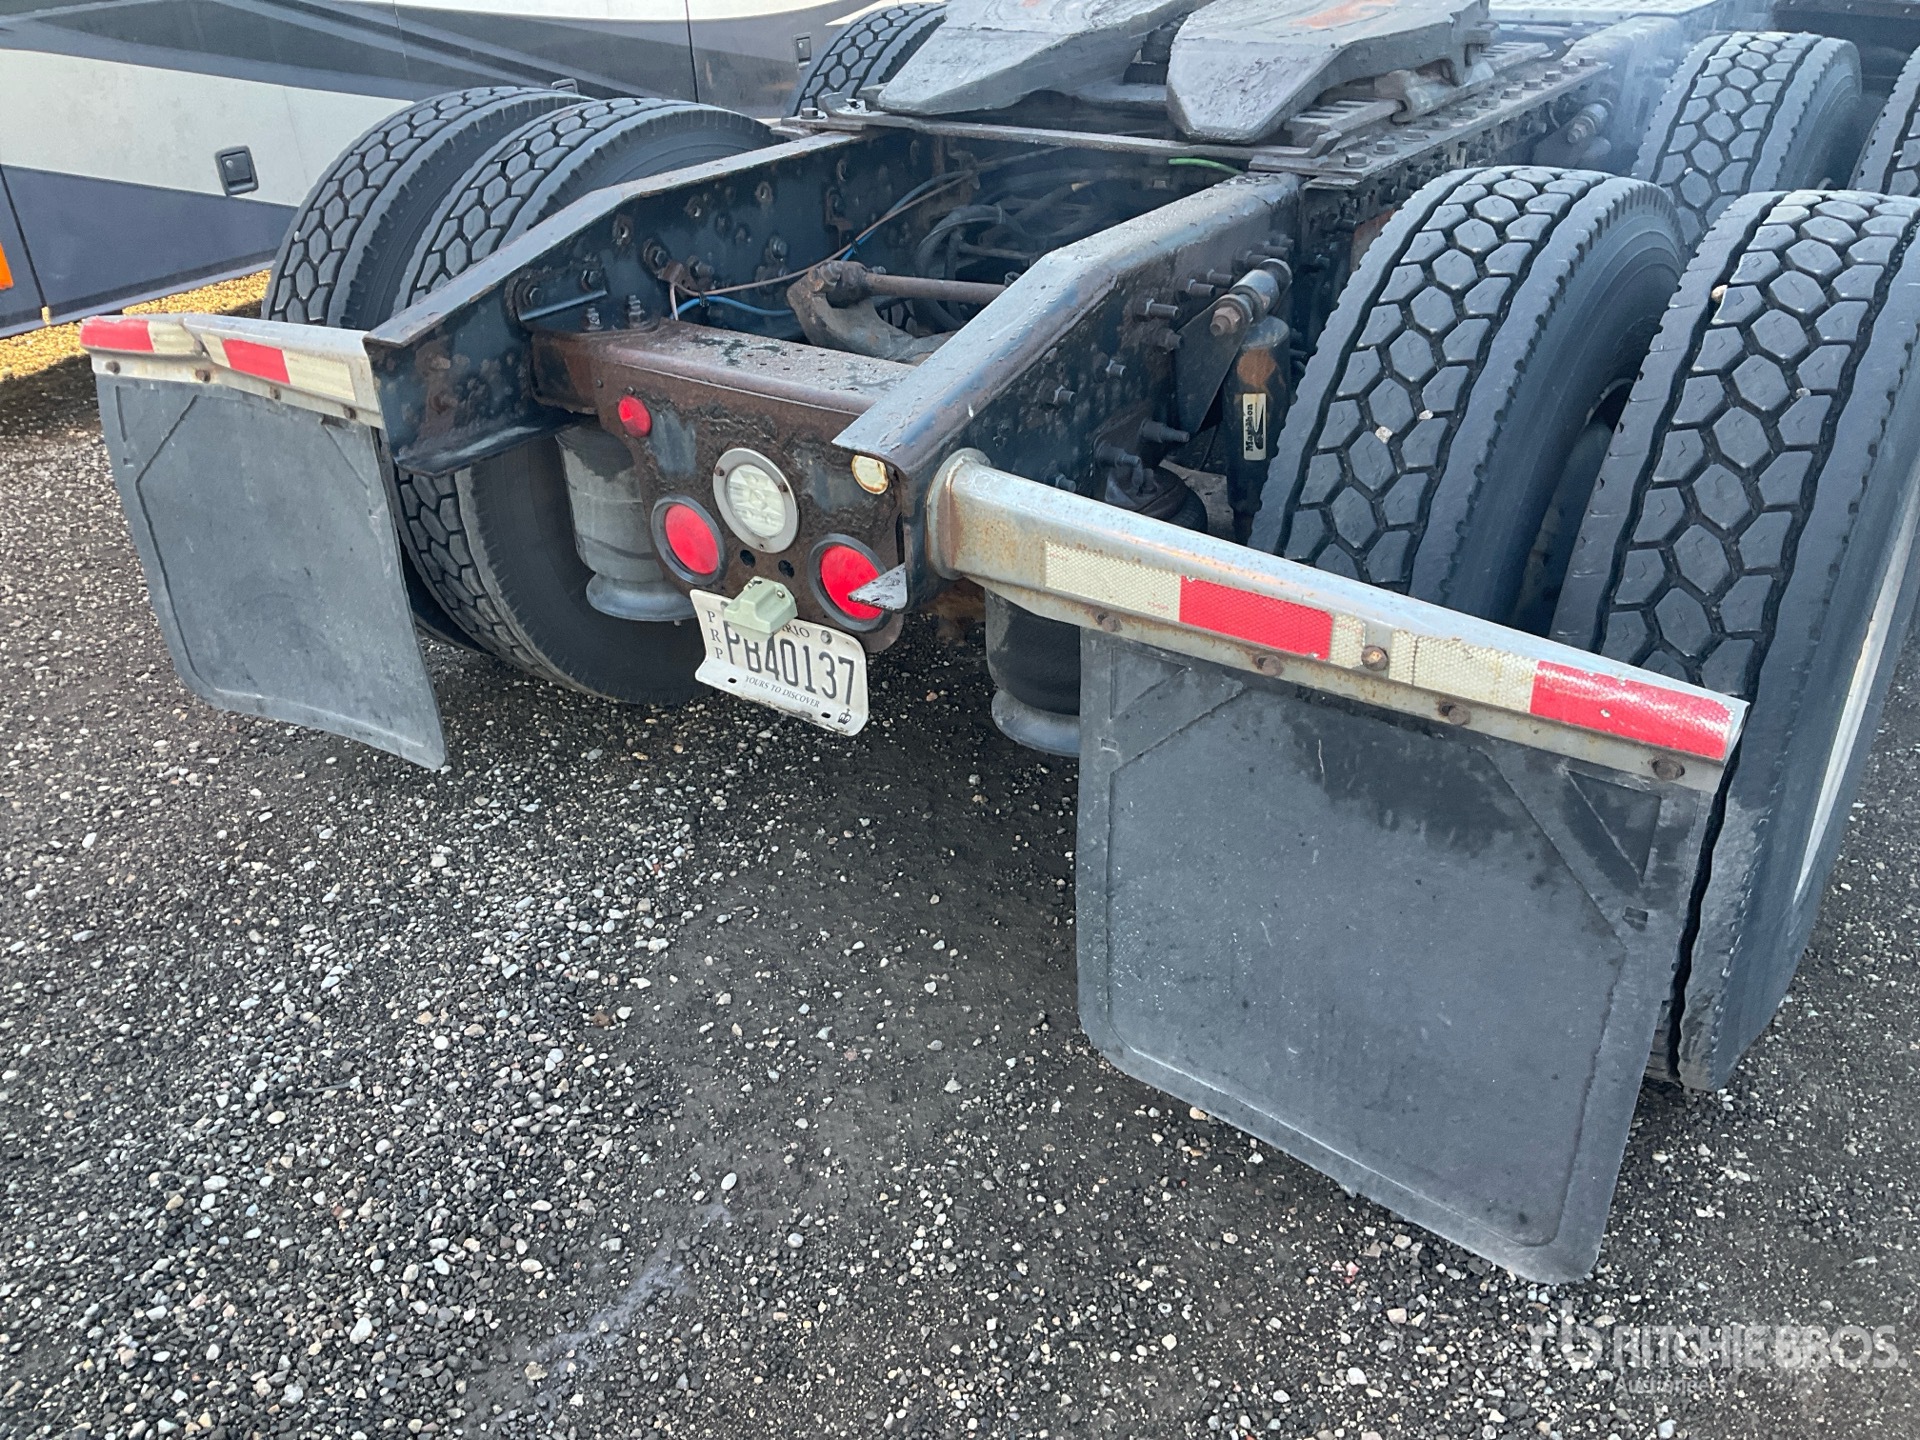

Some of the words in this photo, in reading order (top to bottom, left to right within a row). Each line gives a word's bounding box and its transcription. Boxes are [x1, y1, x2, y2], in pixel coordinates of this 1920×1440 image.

[723, 620, 854, 706] PB40137
[745, 675, 769, 689] YOURS
[770, 684, 782, 693] TO
[782, 688, 820, 708] DISCOVER
